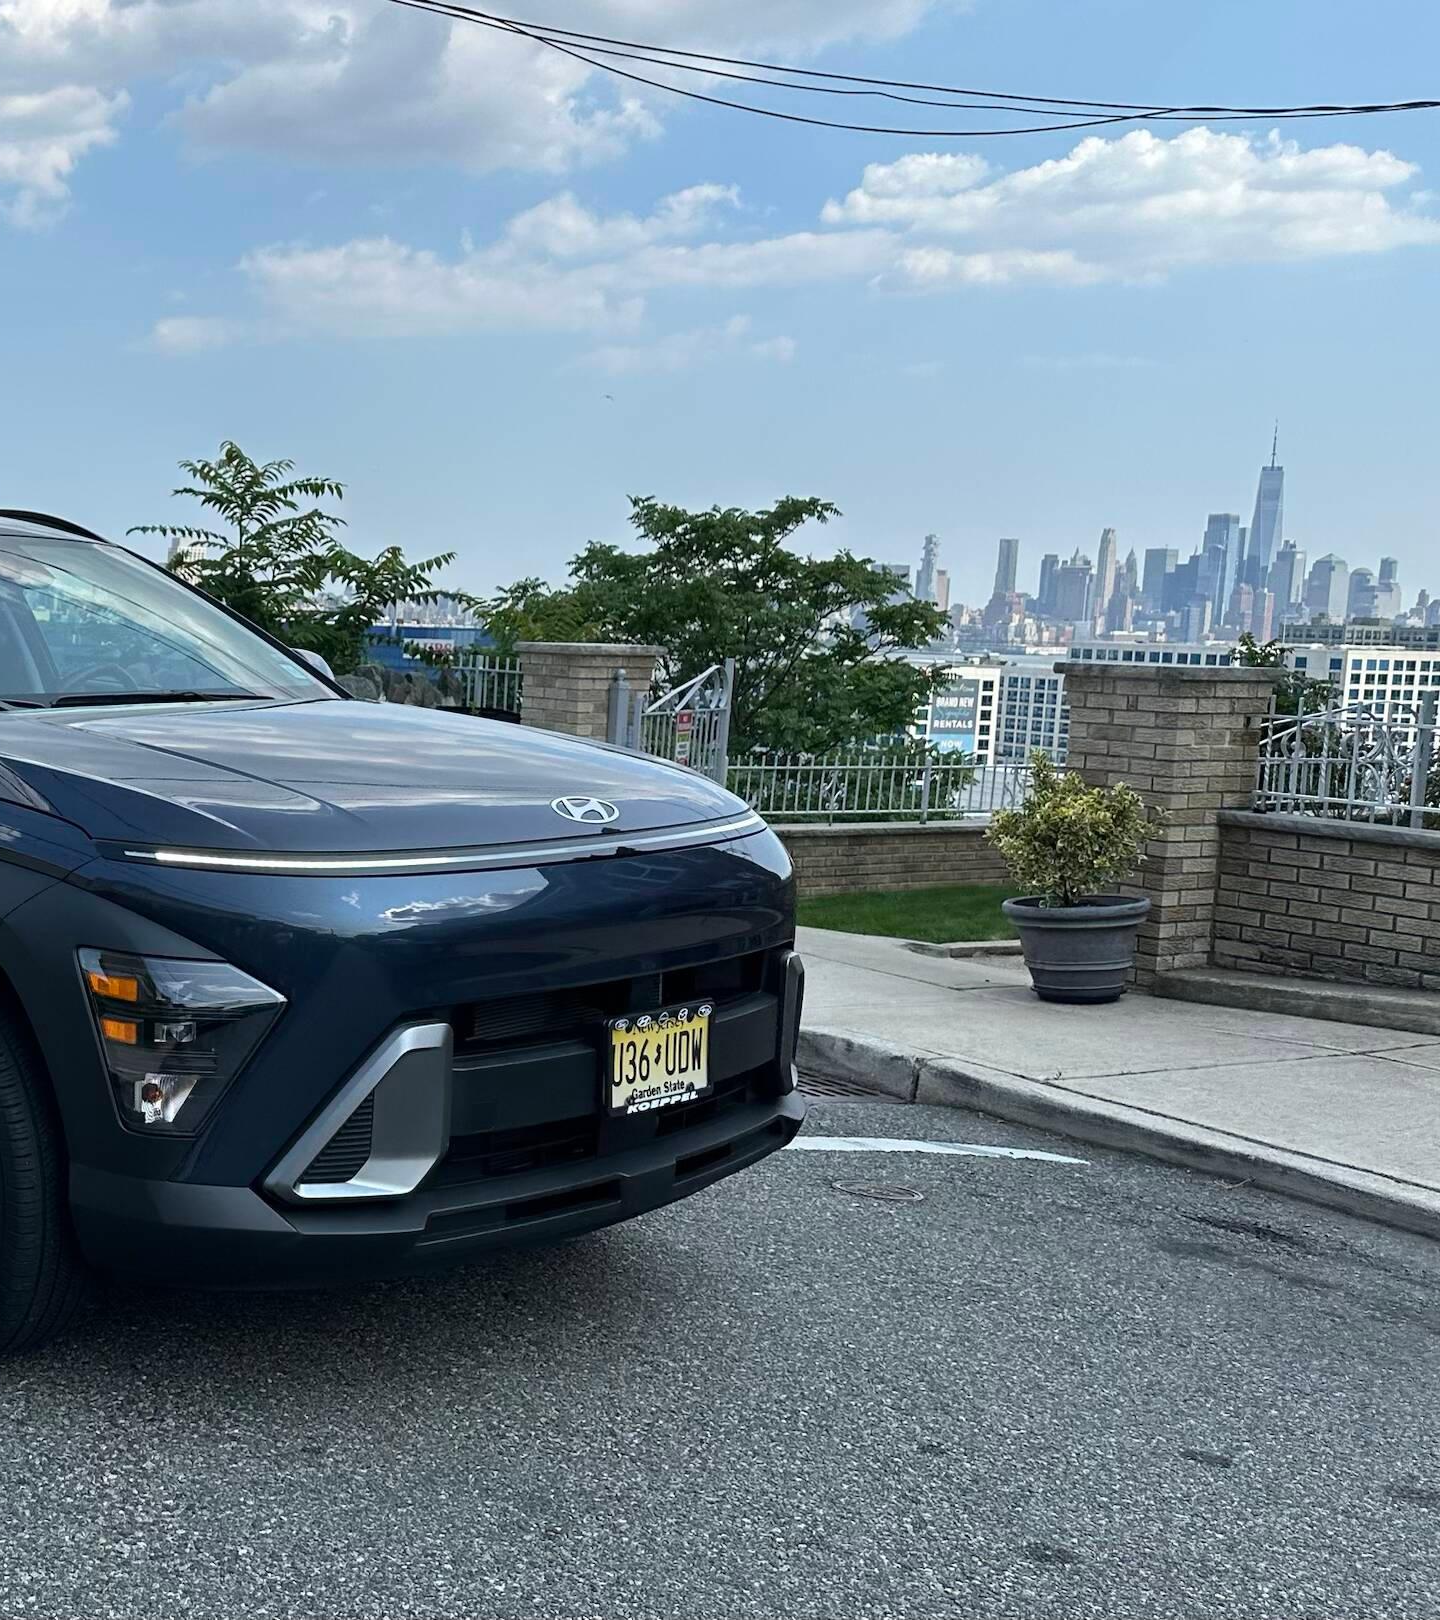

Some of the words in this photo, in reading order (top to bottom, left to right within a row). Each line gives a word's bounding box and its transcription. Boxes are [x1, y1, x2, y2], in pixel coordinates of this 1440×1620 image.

[933, 720, 973, 729] RENTALS
[941, 740, 963, 749] NOW
[631, 1085, 661, 1100] Garden
[663, 1080, 685, 1094] State
[626, 1090, 699, 1115] KOEPPEL
